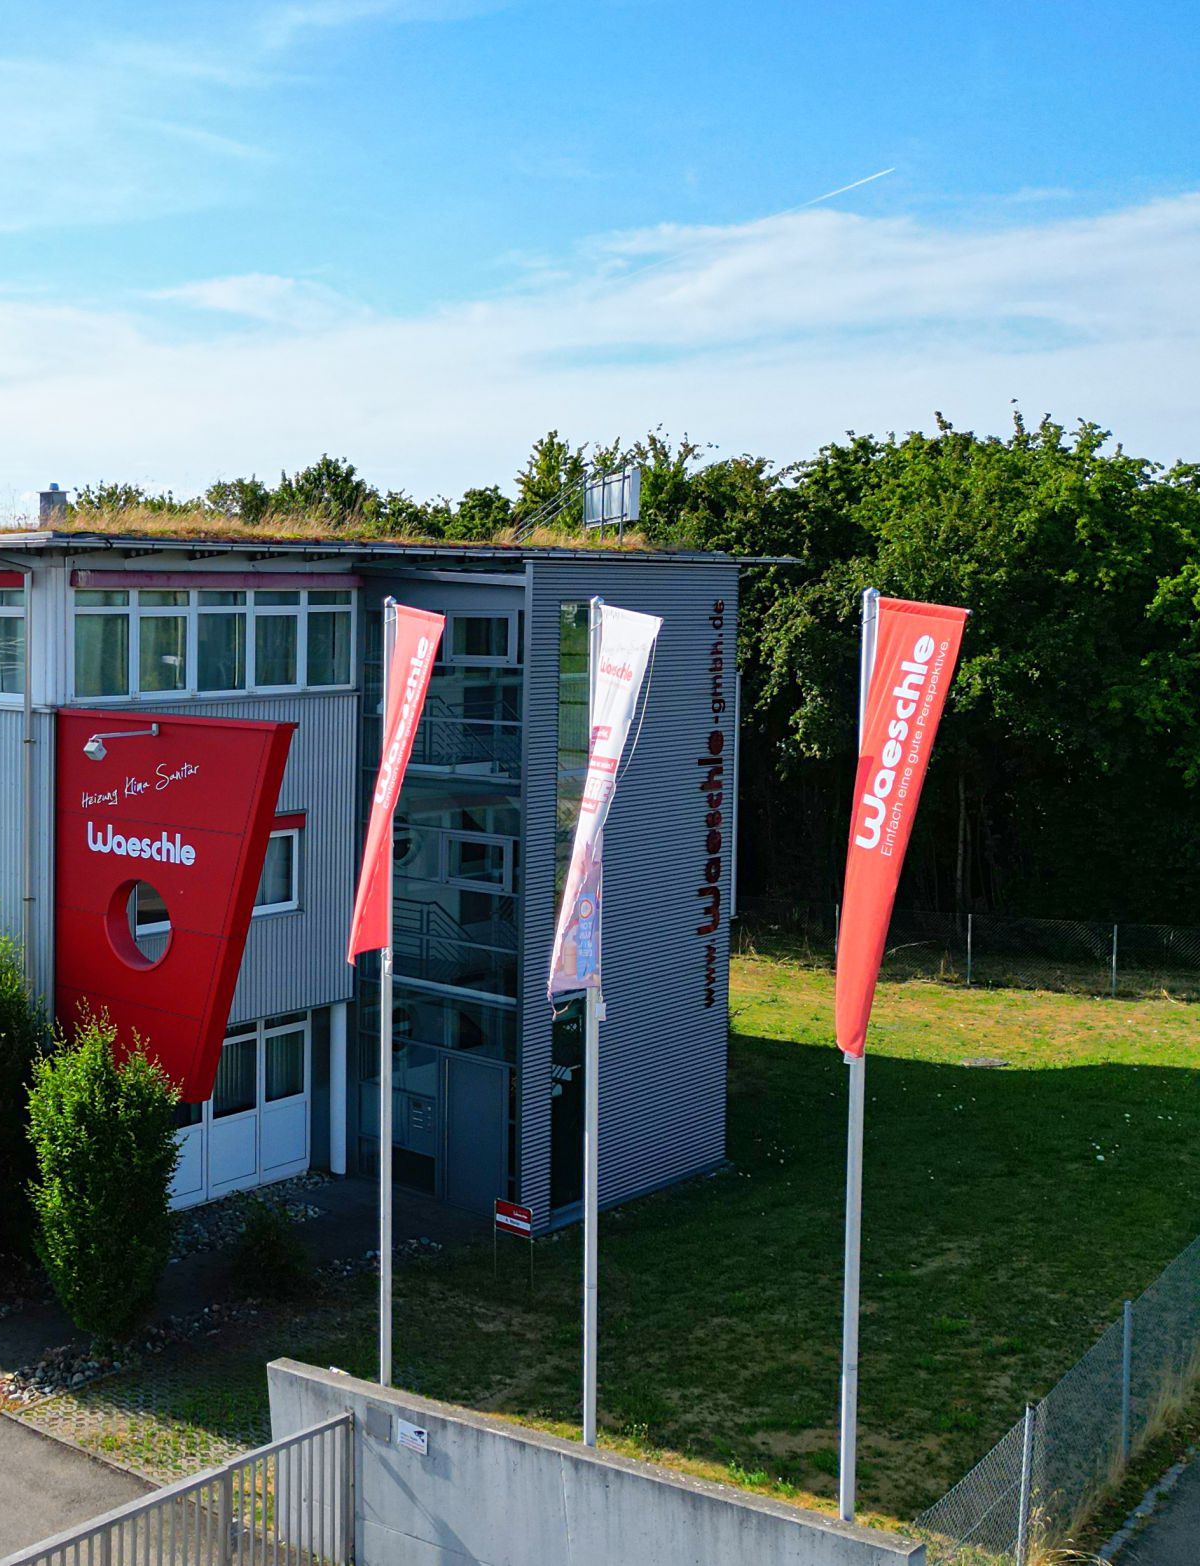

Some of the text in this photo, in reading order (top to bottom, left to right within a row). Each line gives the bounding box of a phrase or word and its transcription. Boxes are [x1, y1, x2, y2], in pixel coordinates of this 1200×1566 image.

[855, 635, 935, 849] Waeschle
[81, 789, 118, 808] Heizung
[124, 776, 150, 798] Klima
[880, 802, 903, 856] Einfach
[898, 767, 913, 798] eine
[908, 731, 923, 764] gute
[87, 821, 196, 866] Waeschle
